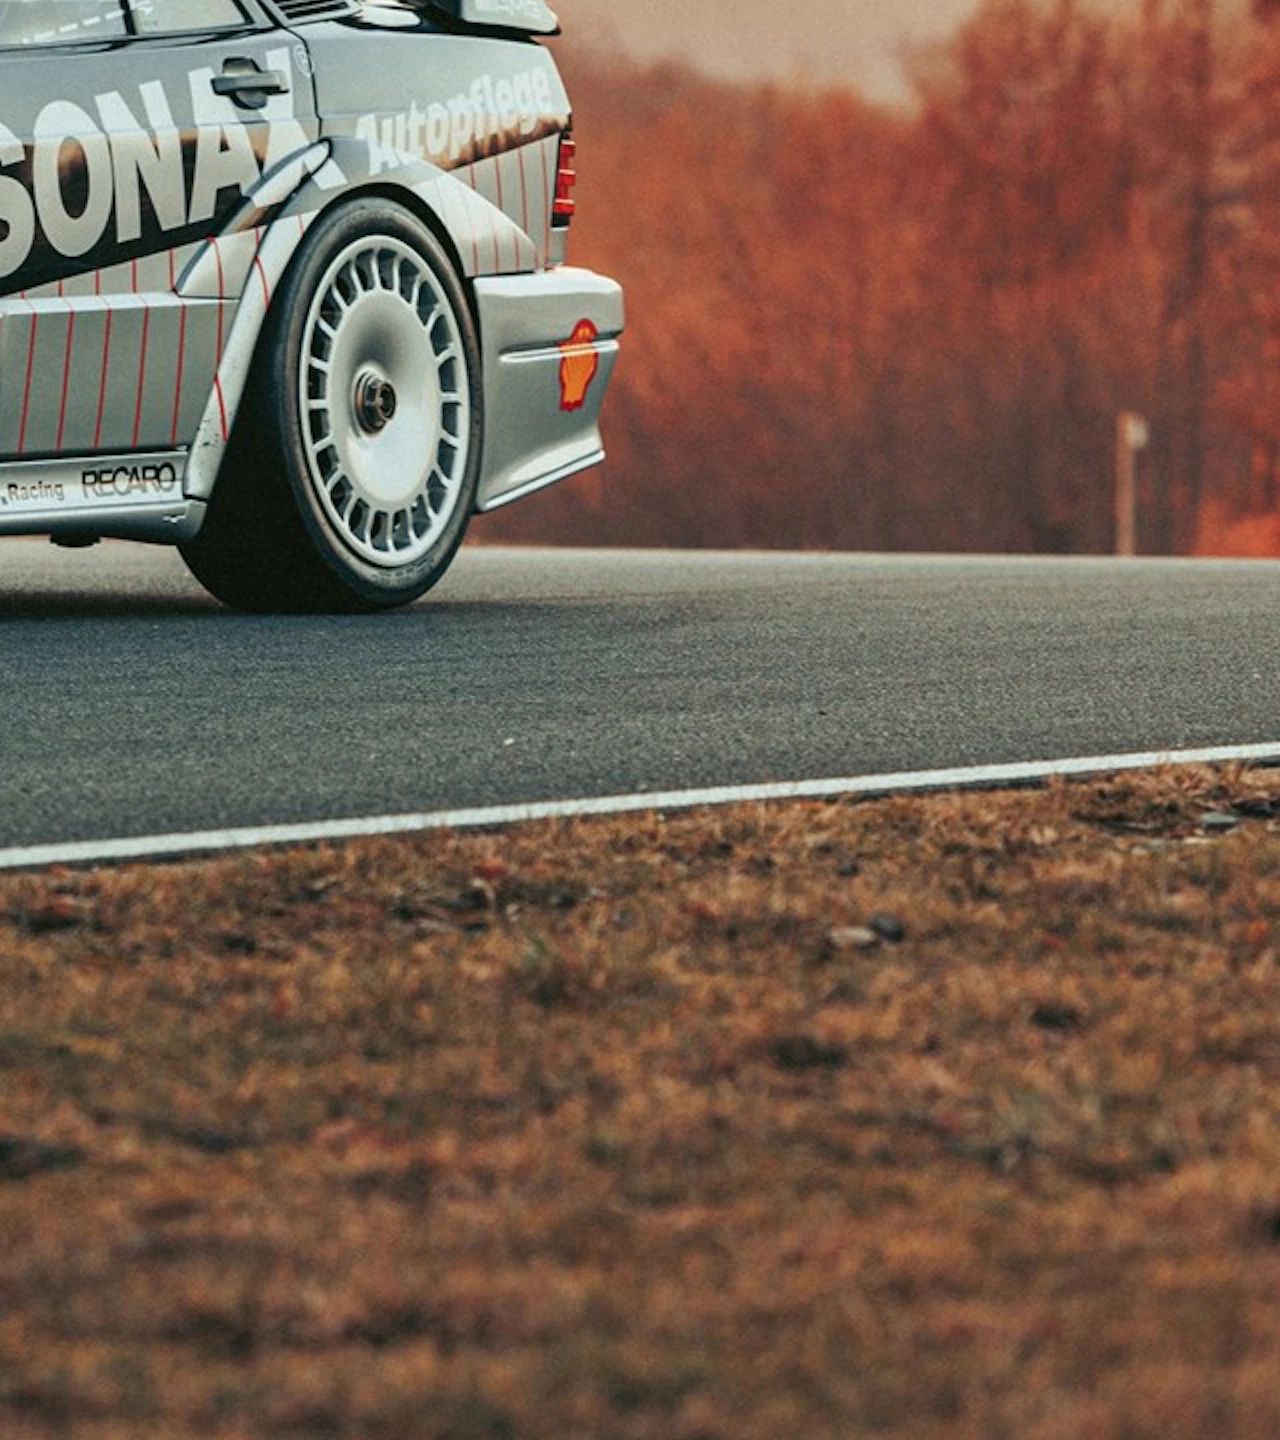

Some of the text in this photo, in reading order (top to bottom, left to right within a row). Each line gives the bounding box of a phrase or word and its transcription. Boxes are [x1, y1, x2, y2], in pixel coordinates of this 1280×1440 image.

[355, 65, 552, 176] Autopflege
[8, 481, 65, 502] Racing
[82, 462, 177, 498] RECARO
